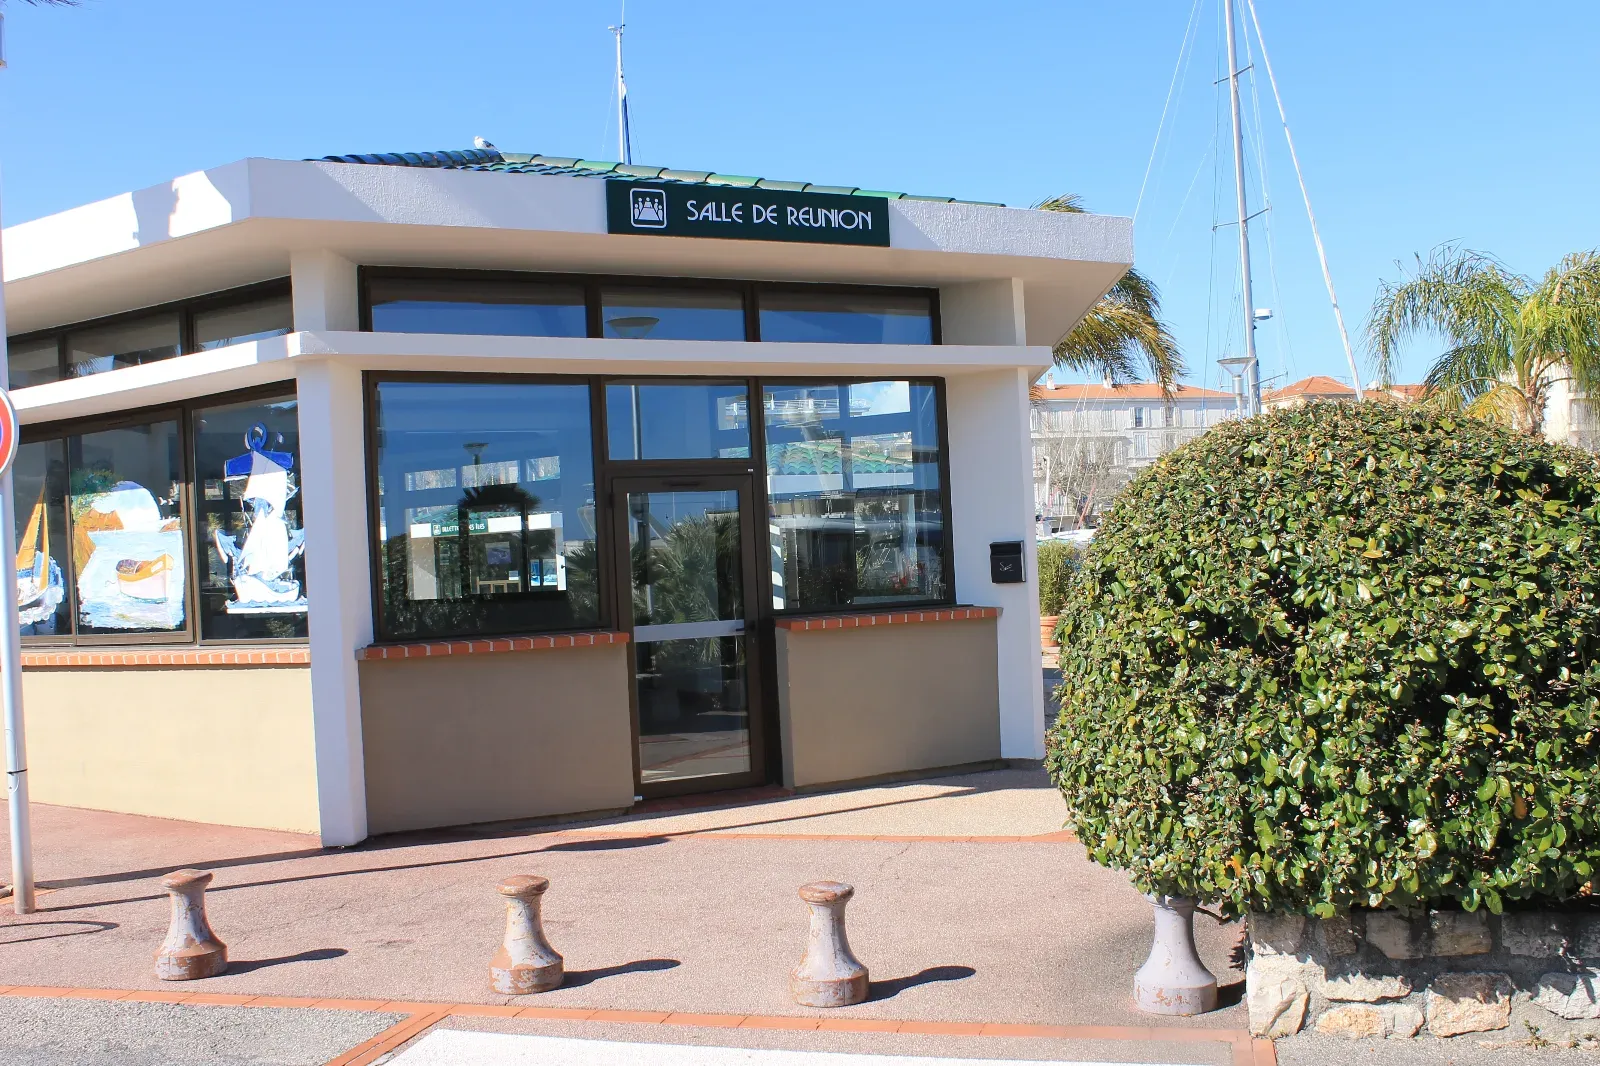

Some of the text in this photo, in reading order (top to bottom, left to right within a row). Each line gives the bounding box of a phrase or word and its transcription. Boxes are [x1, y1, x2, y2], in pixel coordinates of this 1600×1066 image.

[686, 200, 872, 230] SALLE DE REUNION
